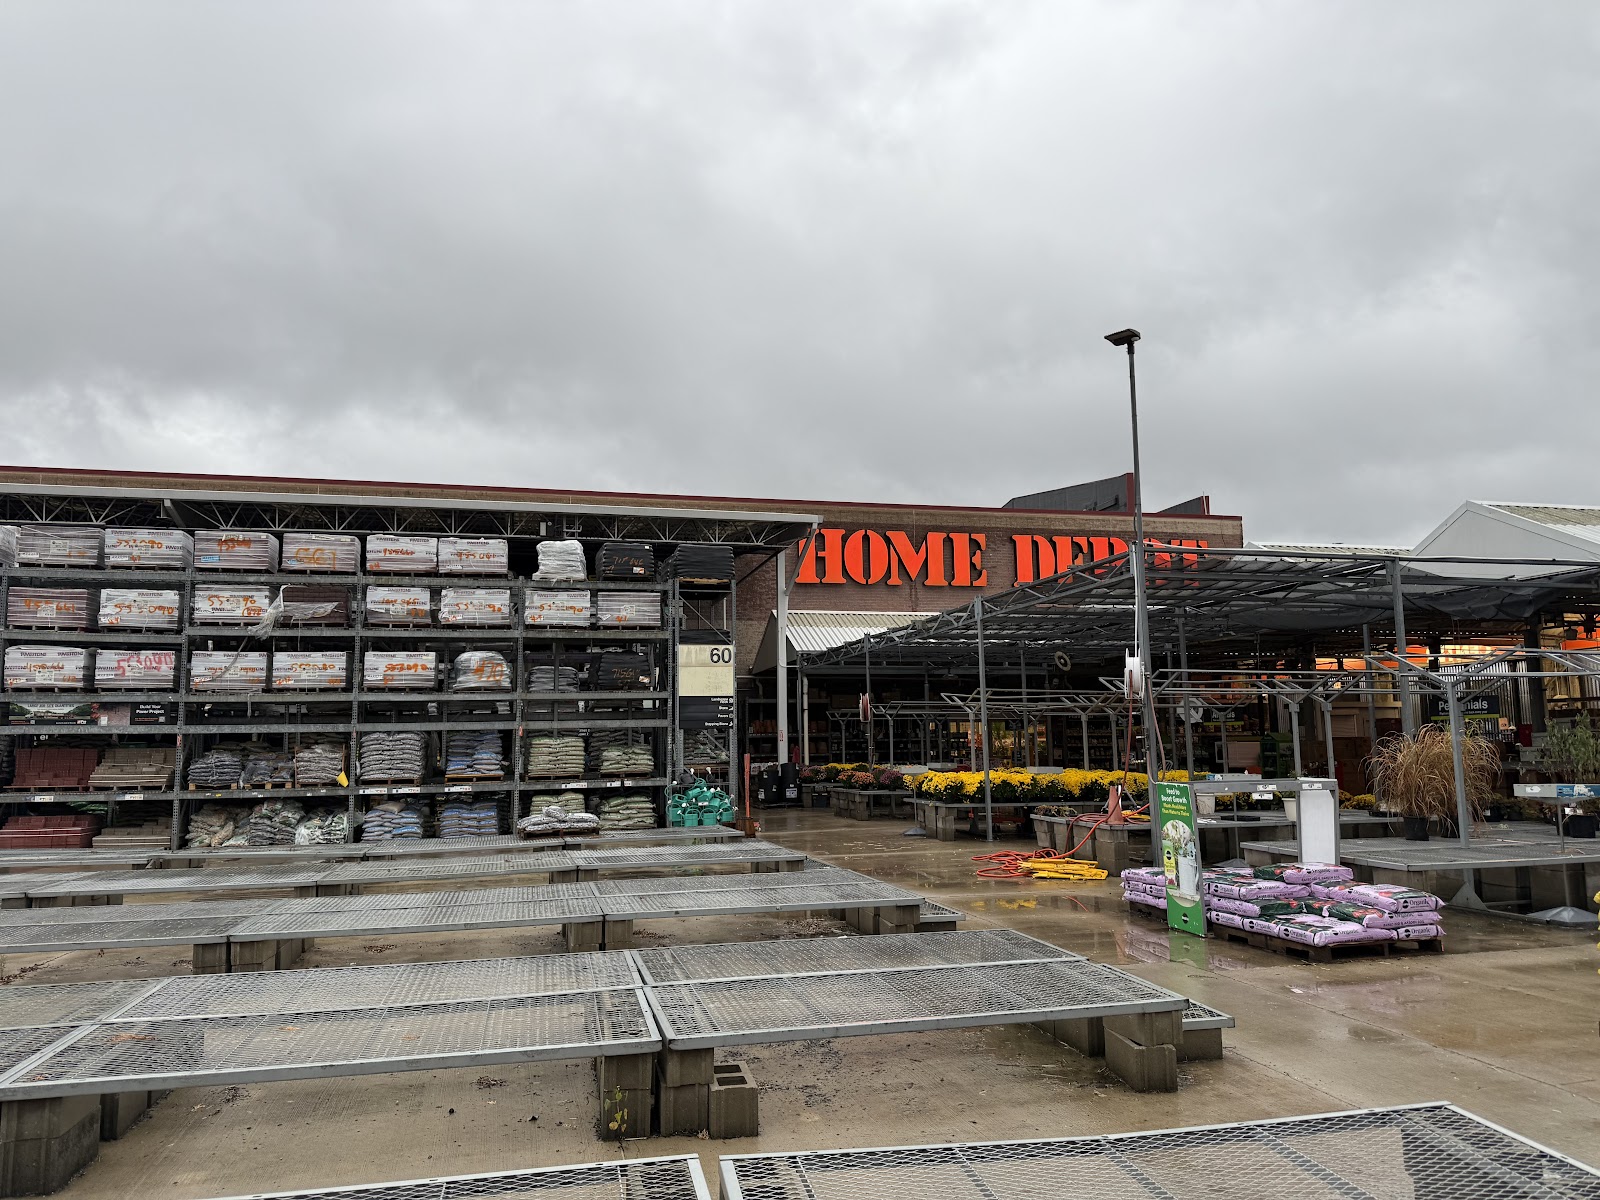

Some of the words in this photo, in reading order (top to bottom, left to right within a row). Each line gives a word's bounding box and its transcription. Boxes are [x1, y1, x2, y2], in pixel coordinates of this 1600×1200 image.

[795, 528, 987, 586] HOME
[710, 647, 732, 664] 60
[1438, 697, 1488, 711] Penials
[1172, 796, 1187, 804] Growth
[1219, 885, 1235, 893] Organic
[1254, 922, 1272, 931] Organic
[1289, 929, 1308, 938] Organic
